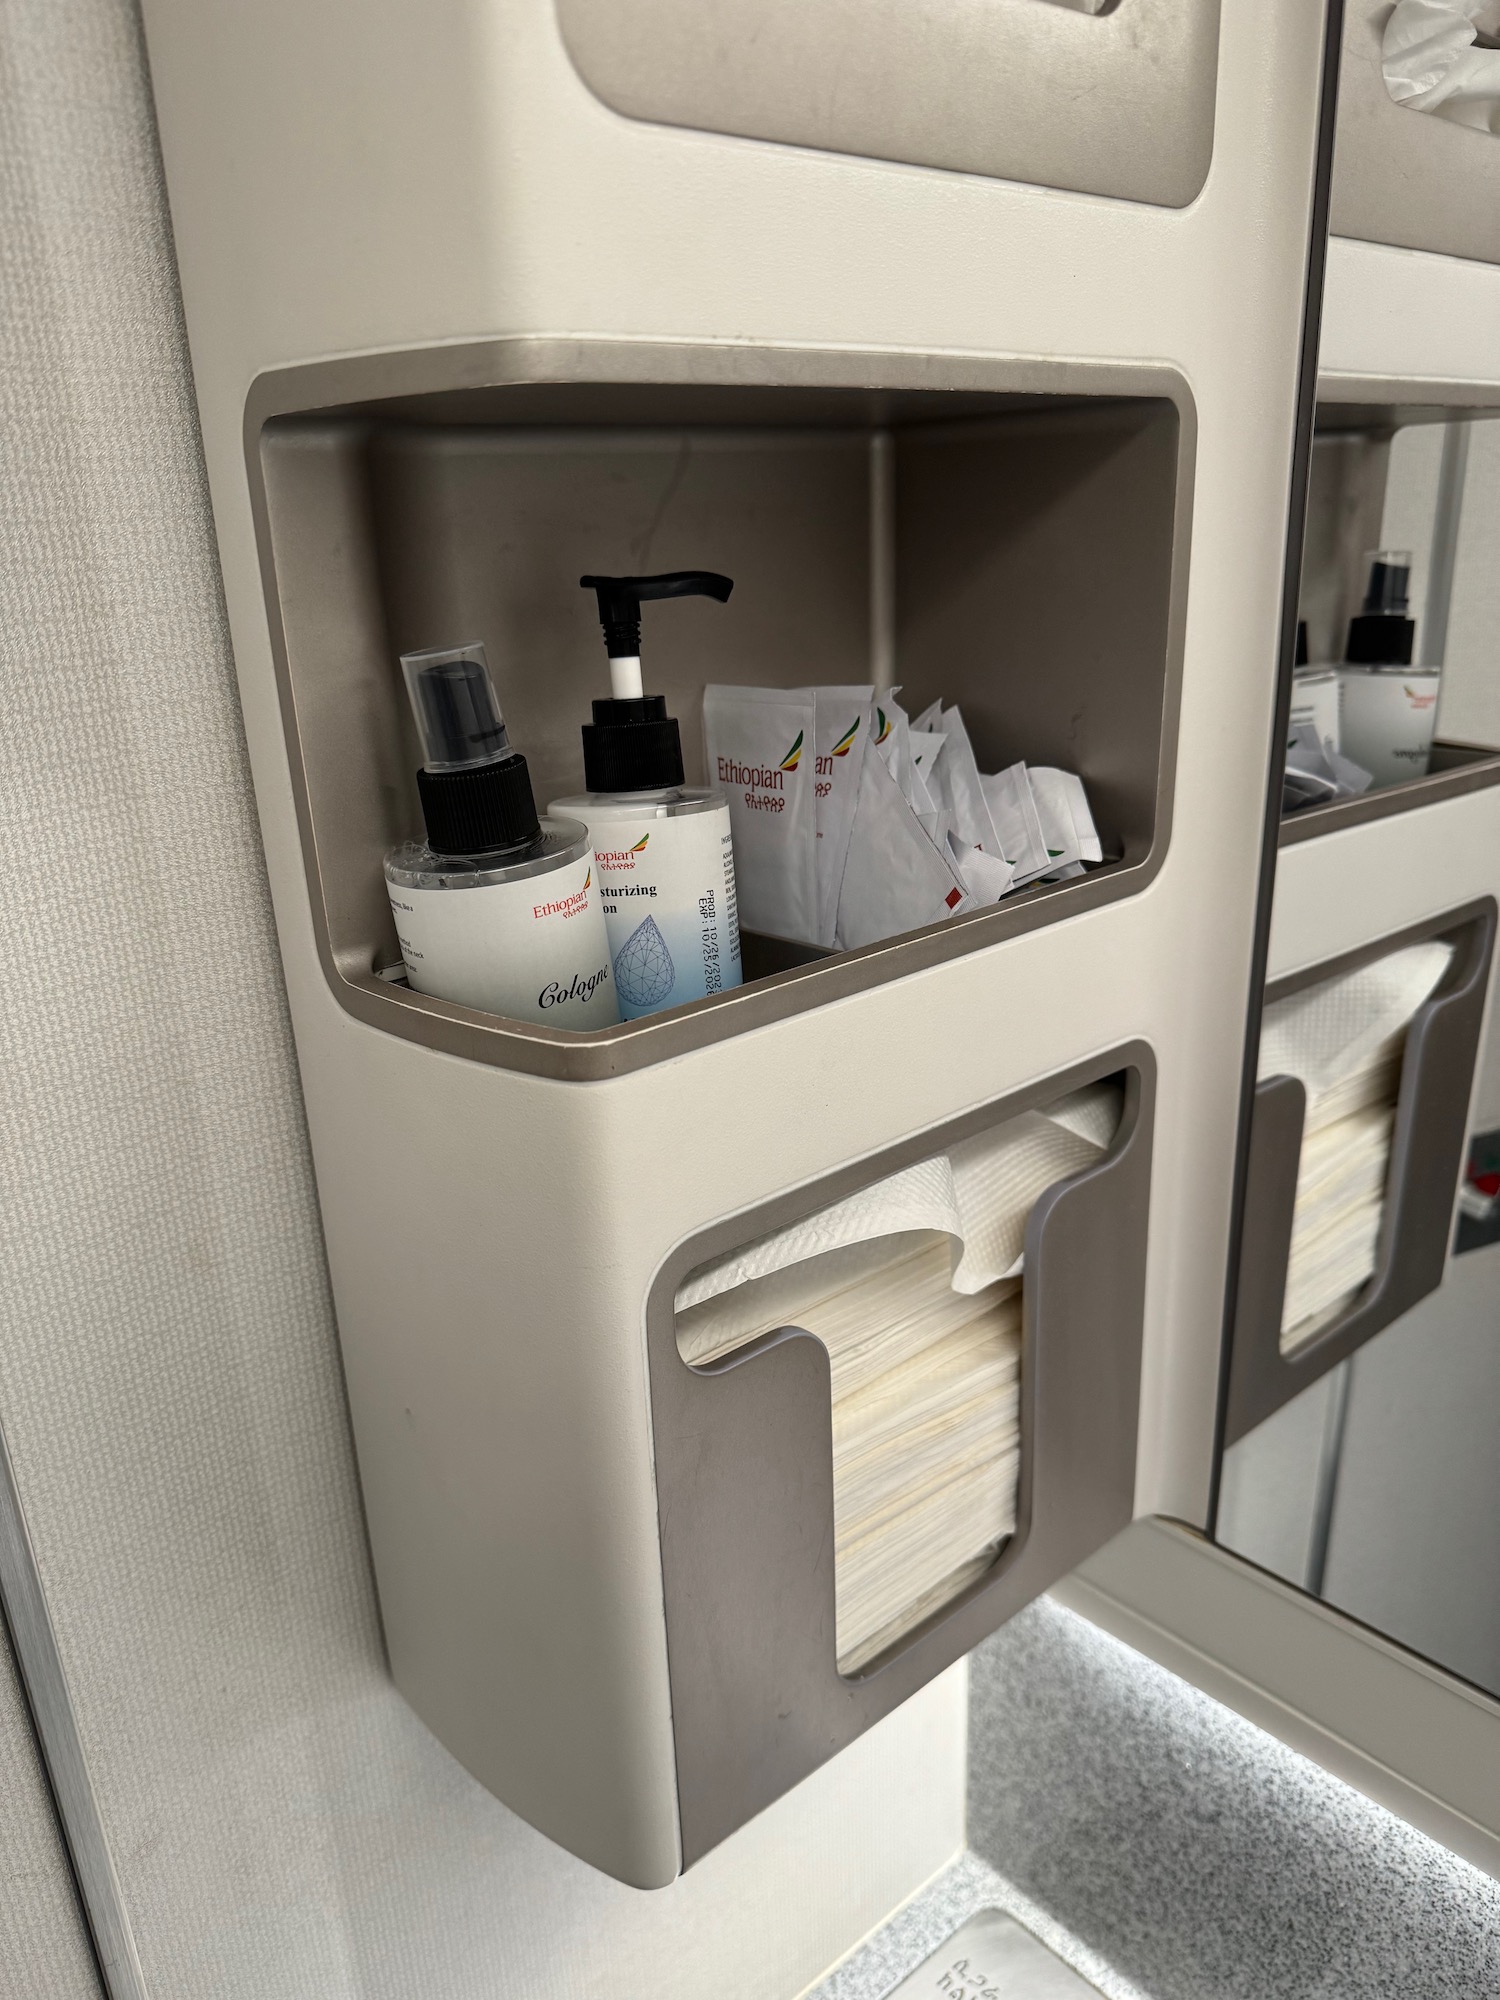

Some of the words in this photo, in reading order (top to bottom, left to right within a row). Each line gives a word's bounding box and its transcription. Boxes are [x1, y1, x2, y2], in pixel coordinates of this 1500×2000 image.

[717, 757, 784, 793] Ethiopian
[594, 850, 635, 863] iopian
[533, 889, 588, 919] Ethiopian
[600, 884, 658, 898] sturizing
[706, 889, 717, 923] PROD:
[698, 898, 709, 924] EXP:
[538, 964, 609, 1009] Cologne
